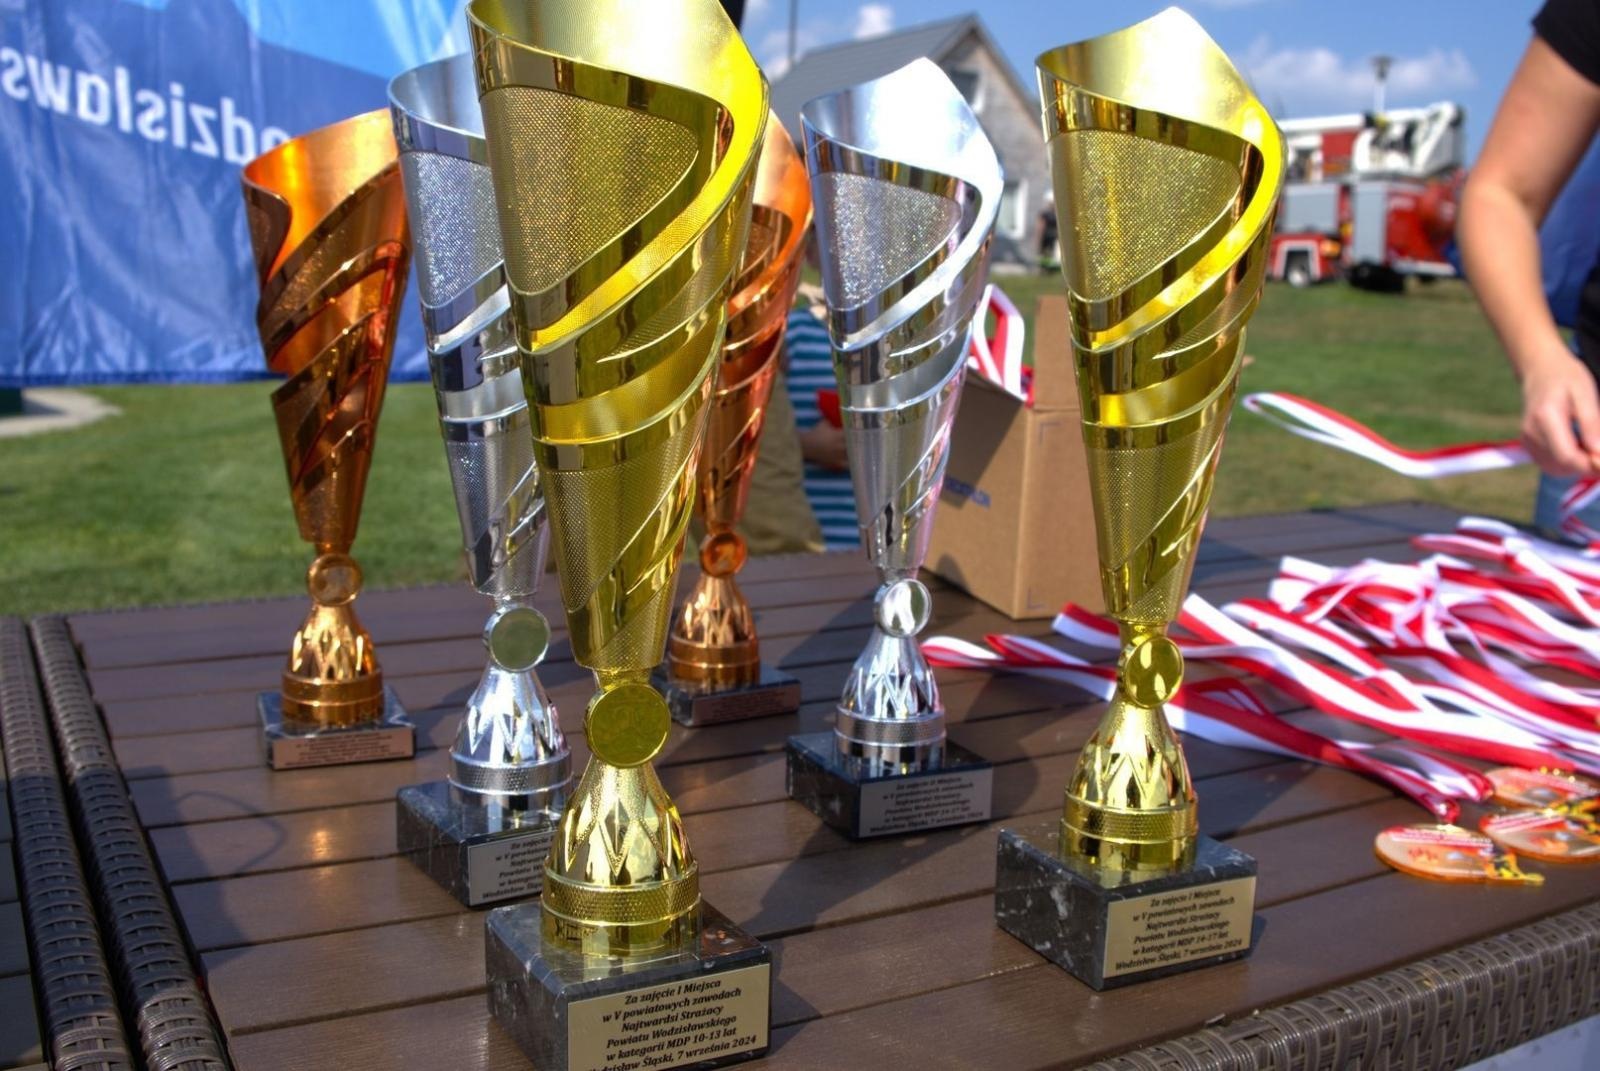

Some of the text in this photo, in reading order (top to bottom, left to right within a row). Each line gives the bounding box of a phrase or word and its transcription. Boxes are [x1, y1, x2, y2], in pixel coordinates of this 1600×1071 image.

[602, 988, 741, 1022] w V powiatowych zawodach
[625, 979, 721, 1005] Za zajęcie I Miejsca
[606, 1016, 737, 1048] Powiatu Wodzisławskiego
[622, 1005, 724, 1033] Najtwardsi Strażacy
[618, 1044, 664, 1060] kategorii
[666, 1038, 691, 1050] MDP
[694, 1030, 721, 1044] 10-13
[723, 1027, 737, 1037] lat
[642, 1053, 674, 1068] Śląski,
[678, 1050, 683, 1059] 7
[685, 1042, 730, 1058] września
[732, 1035, 757, 1048] 2024
